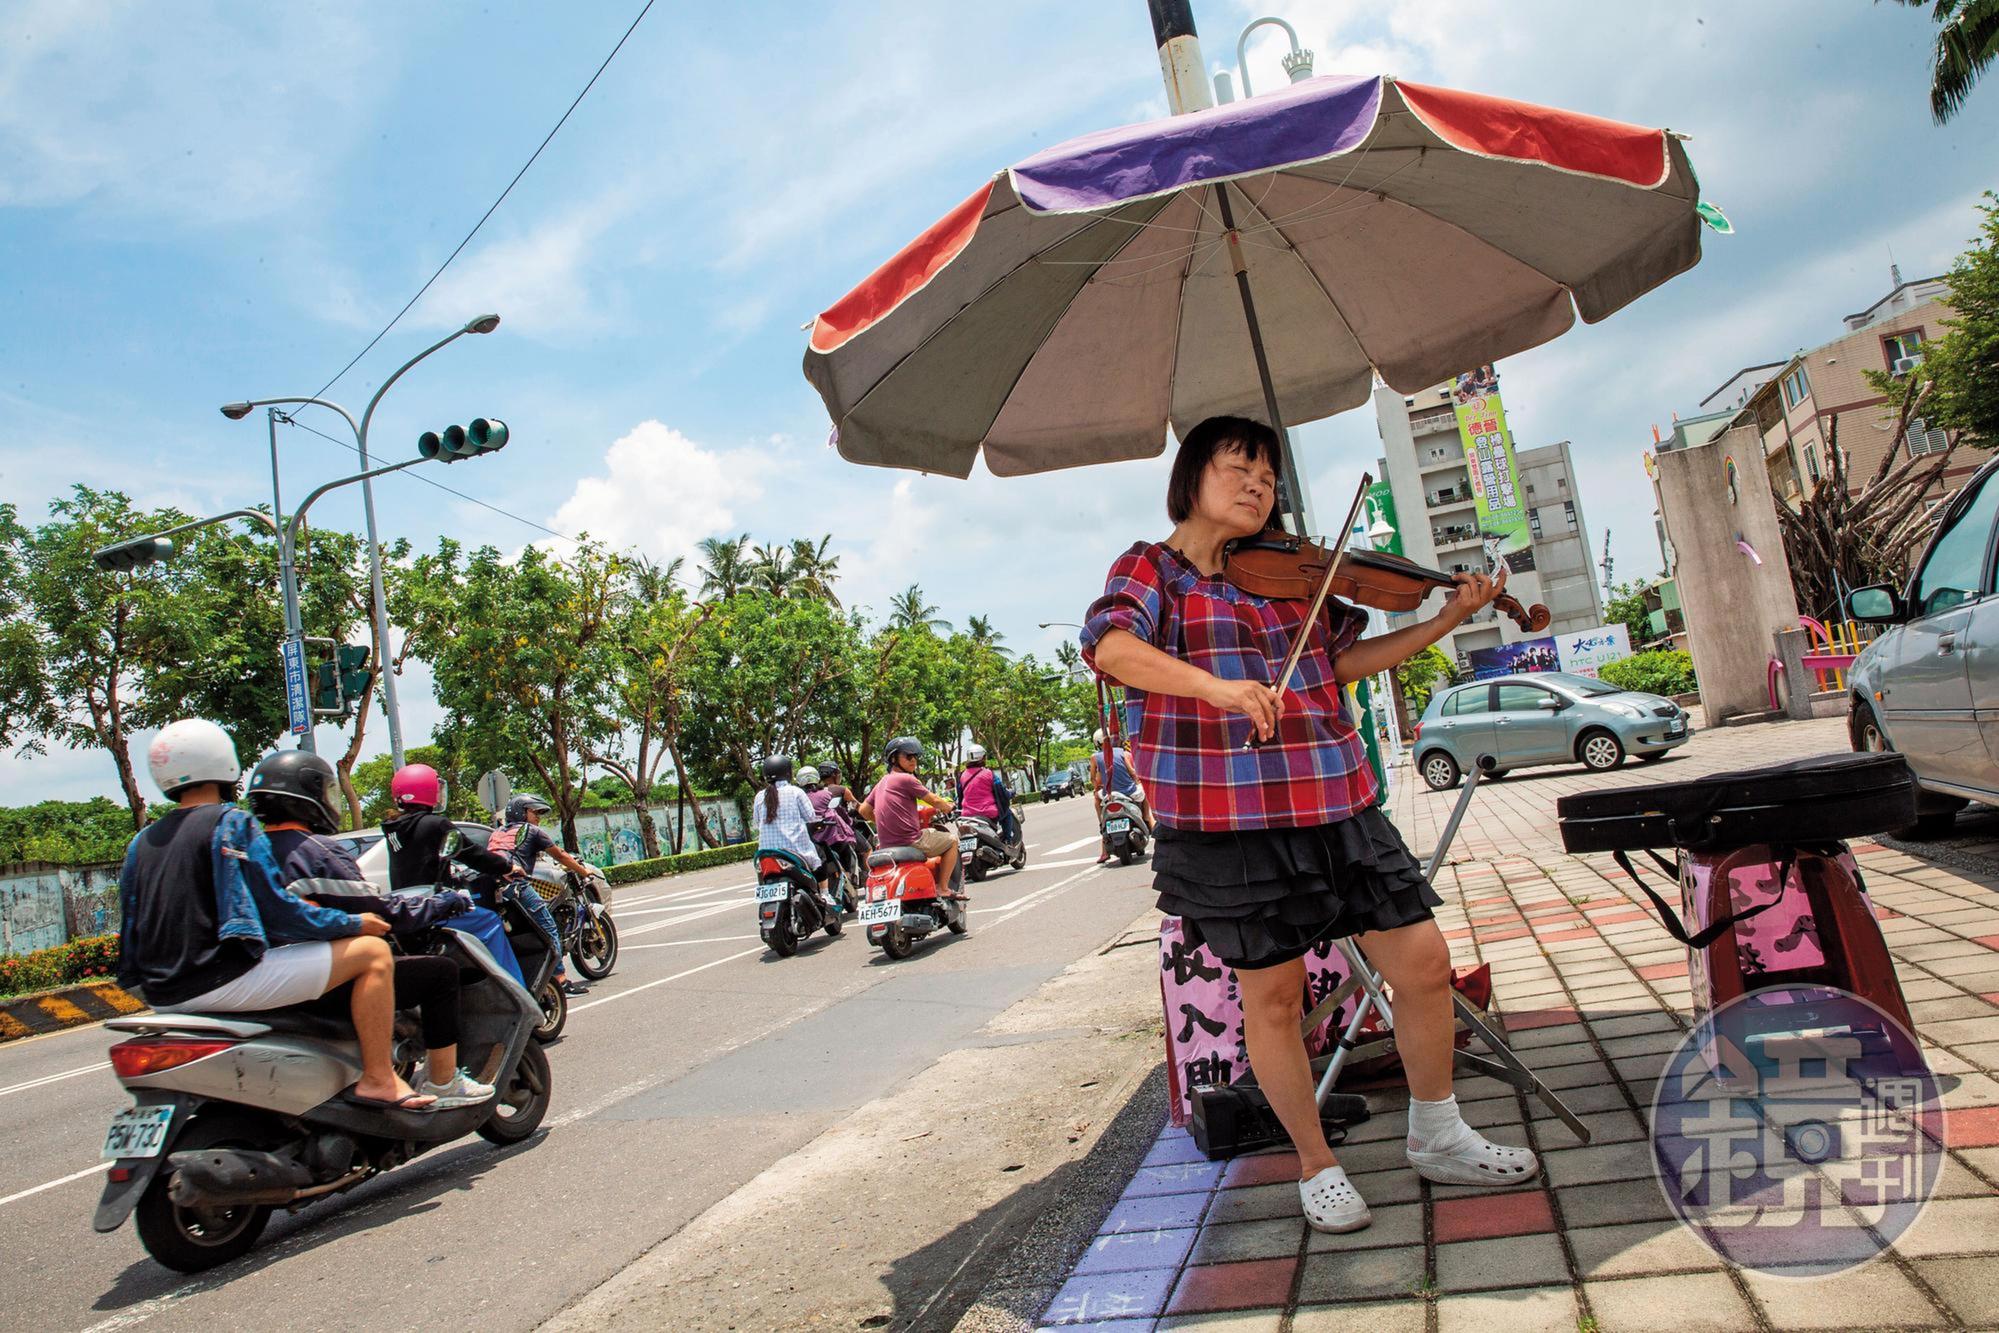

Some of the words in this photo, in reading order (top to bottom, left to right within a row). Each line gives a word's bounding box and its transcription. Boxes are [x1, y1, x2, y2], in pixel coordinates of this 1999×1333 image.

[287, 643, 306, 723] 屏東市清潔隊
[860, 904, 899, 921] AEH-5677
